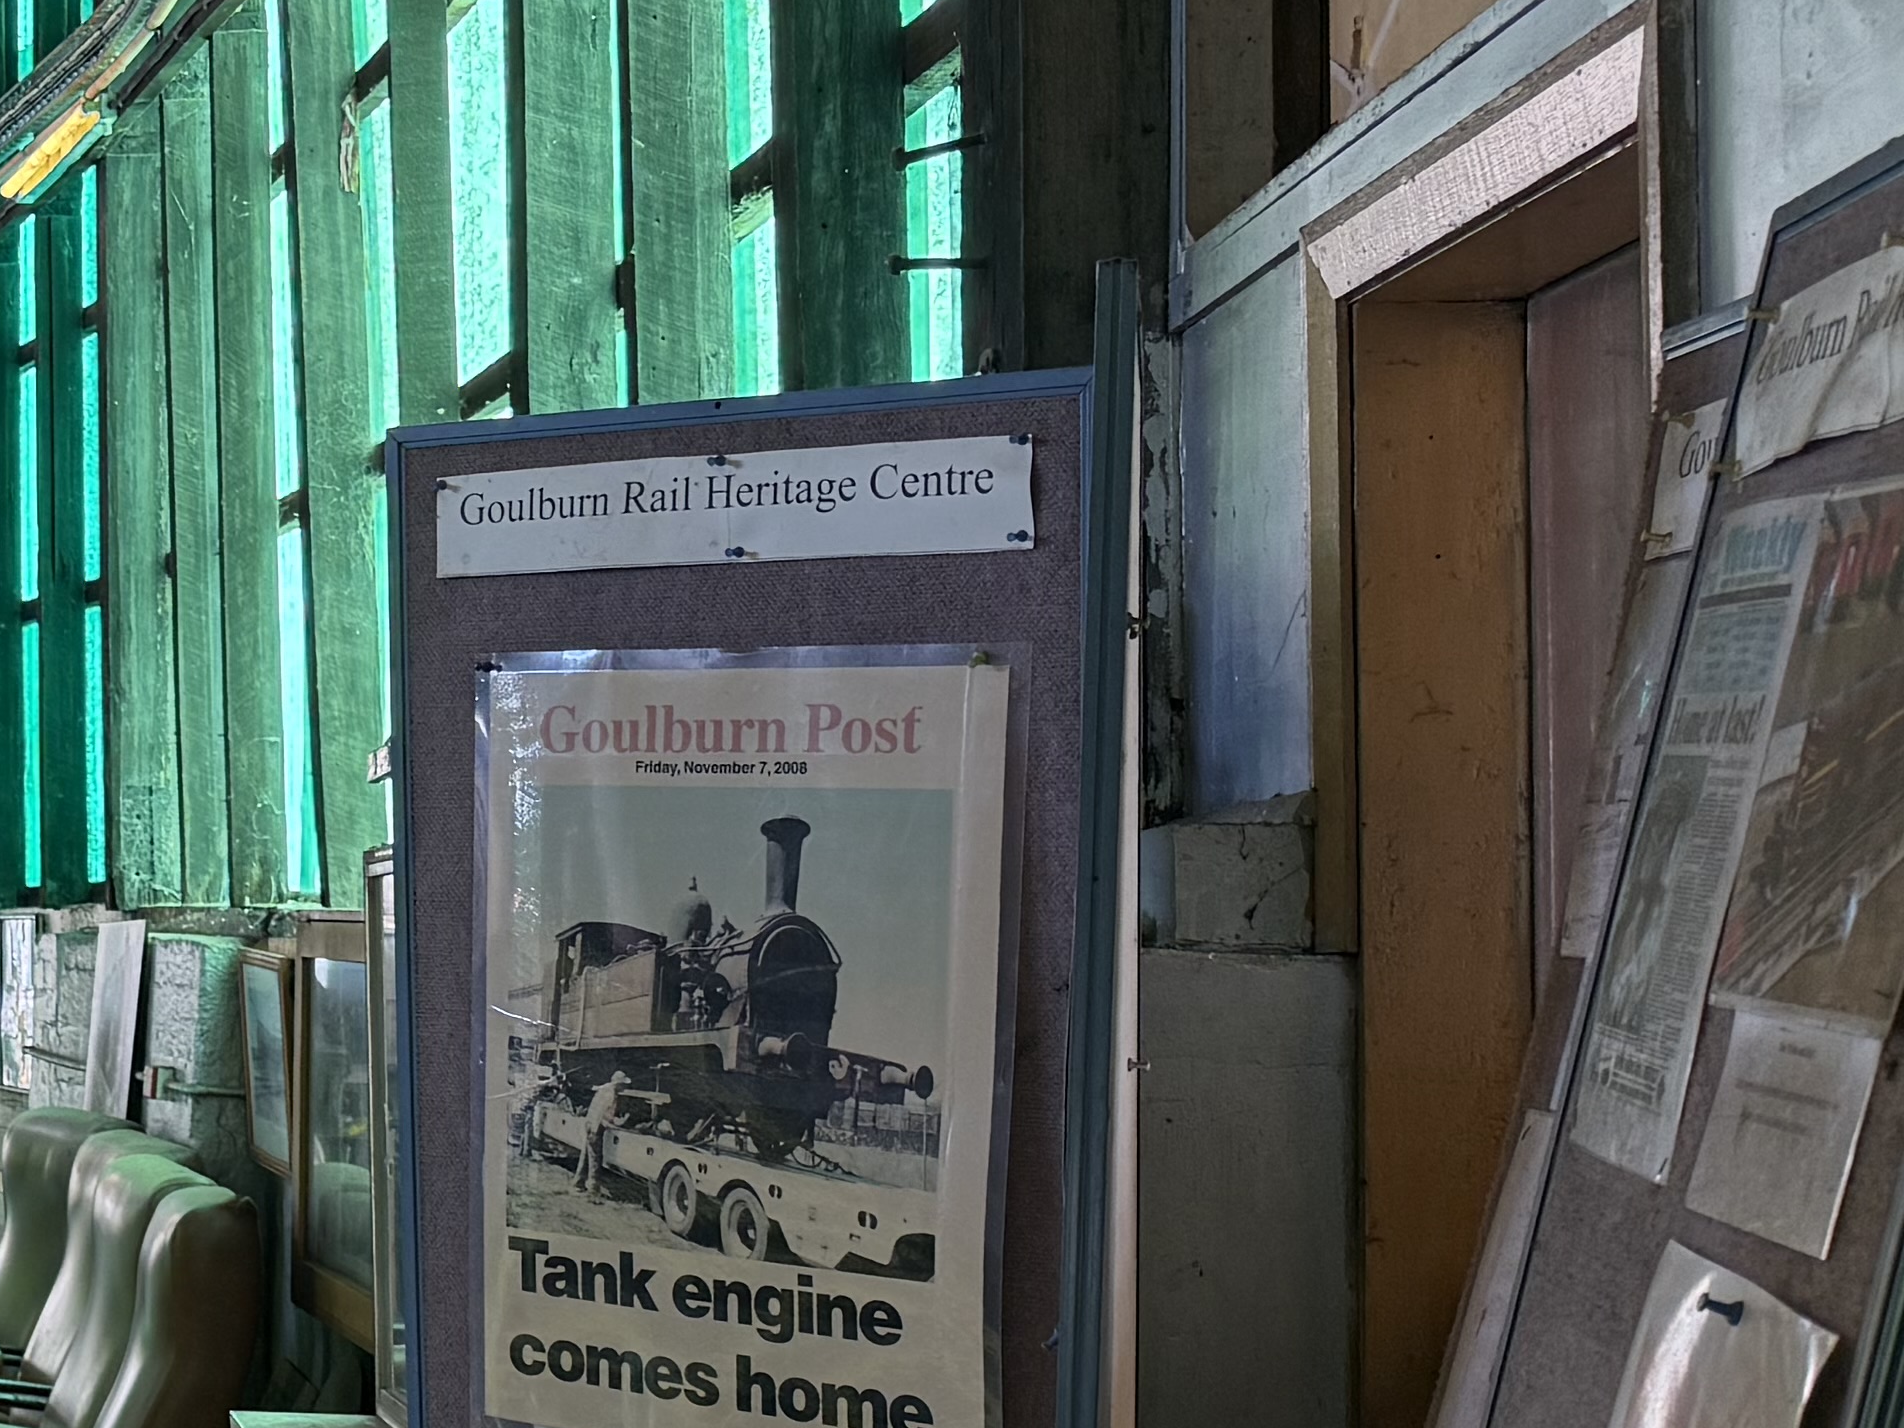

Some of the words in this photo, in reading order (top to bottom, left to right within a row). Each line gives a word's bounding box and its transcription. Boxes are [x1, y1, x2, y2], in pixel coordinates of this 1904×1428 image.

[459, 486, 609, 526] Goulburn
[621, 477, 692, 515] Rail
[703, 469, 857, 512] Heritage
[869, 462, 995, 501] Centre
[539, 704, 789, 754] Goulburn
[803, 703, 924, 754] Post
[635, 760, 682, 776] Friday,
[684, 761, 756, 774] November
[759, 761, 771, 776] 7,
[774, 760, 808, 775] 2008
[508, 1236, 658, 1312] Tank
[672, 1273, 904, 1346] engine
[508, 1333, 719, 1408] comes
